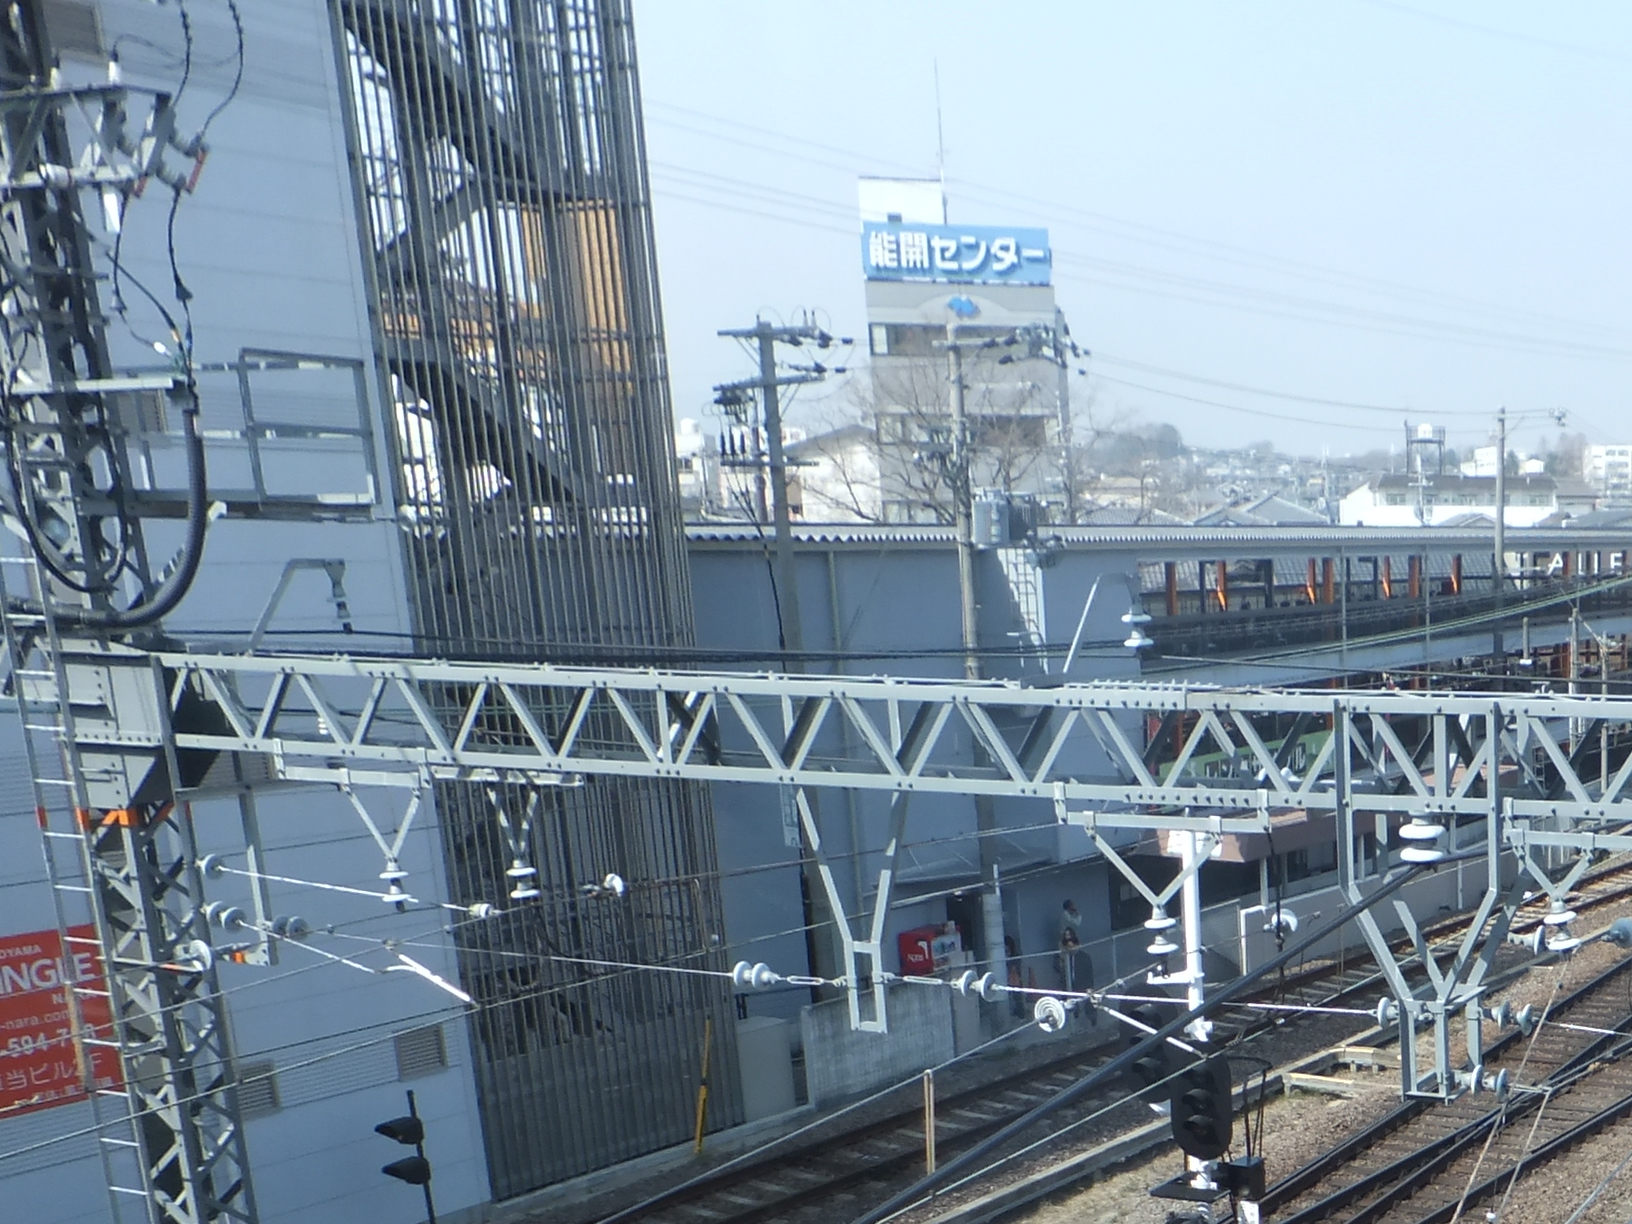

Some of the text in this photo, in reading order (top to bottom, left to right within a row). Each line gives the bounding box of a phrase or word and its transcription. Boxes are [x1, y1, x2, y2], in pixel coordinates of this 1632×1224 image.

[868, 230, 1045, 271] 能開センター
